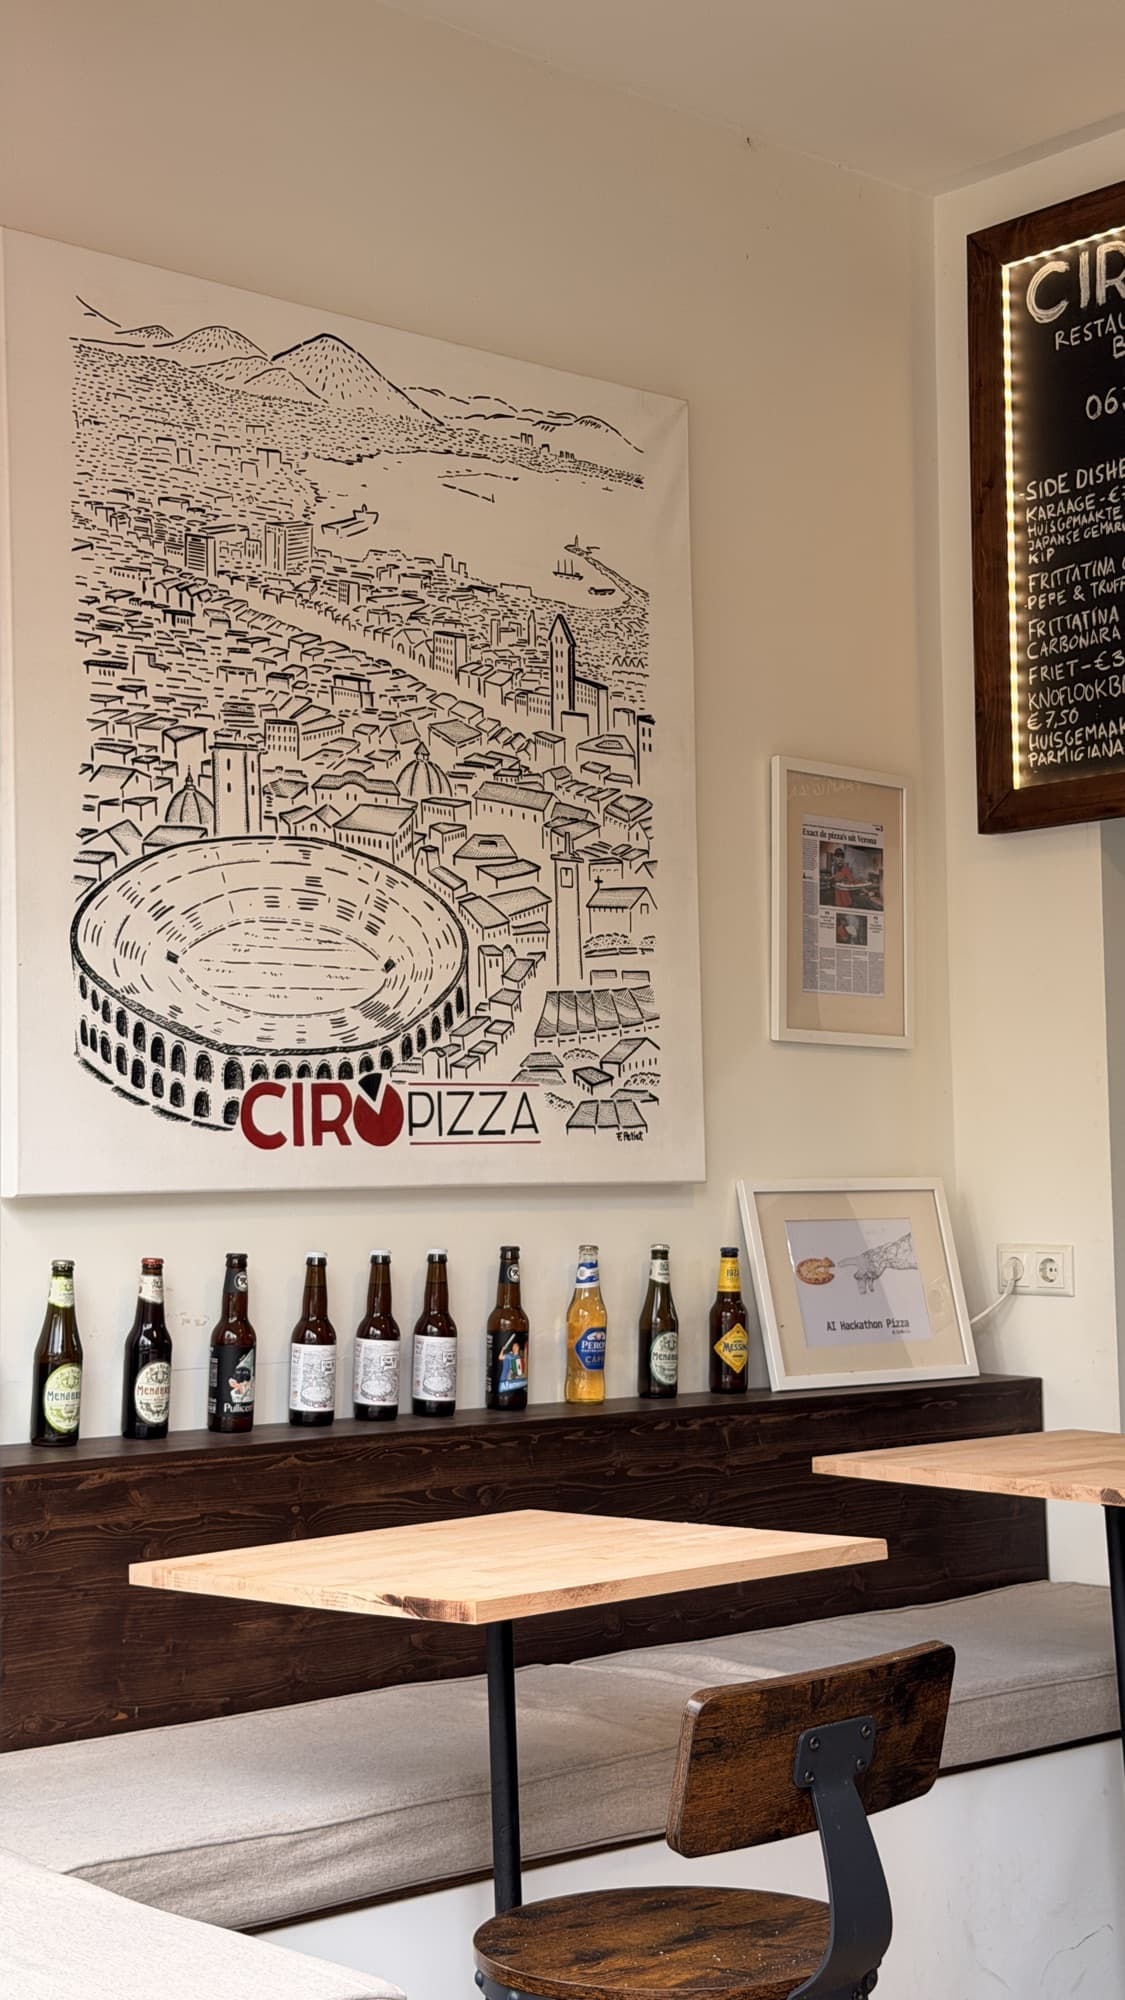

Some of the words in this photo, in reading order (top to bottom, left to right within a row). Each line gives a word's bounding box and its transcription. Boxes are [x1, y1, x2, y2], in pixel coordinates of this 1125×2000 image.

[1027, 529, 1081, 551] JAPANSE
[1028, 547, 1055, 565] KIP
[1028, 556, 1116, 593] FRITTATINA
[1027, 589, 1067, 610] PEPE
[1072, 585, 1086, 602] &
[1028, 605, 1120, 641] FRITTATINA
[1027, 625, 1121, 660] CARBONARA
[1027, 738, 1125, 768] PARMIGIANA
[802, 828, 819, 837] Exact
[820, 829, 827, 838] de
[848, 834, 856, 842] uit
[857, 835, 877, 845] Verona
[408, 1090, 540, 1137] PIZZA
[826, 1321, 837, 1331] AI
[840, 1319, 883, 1331] Hackathon
[886, 1318, 910, 1328] Pizza
